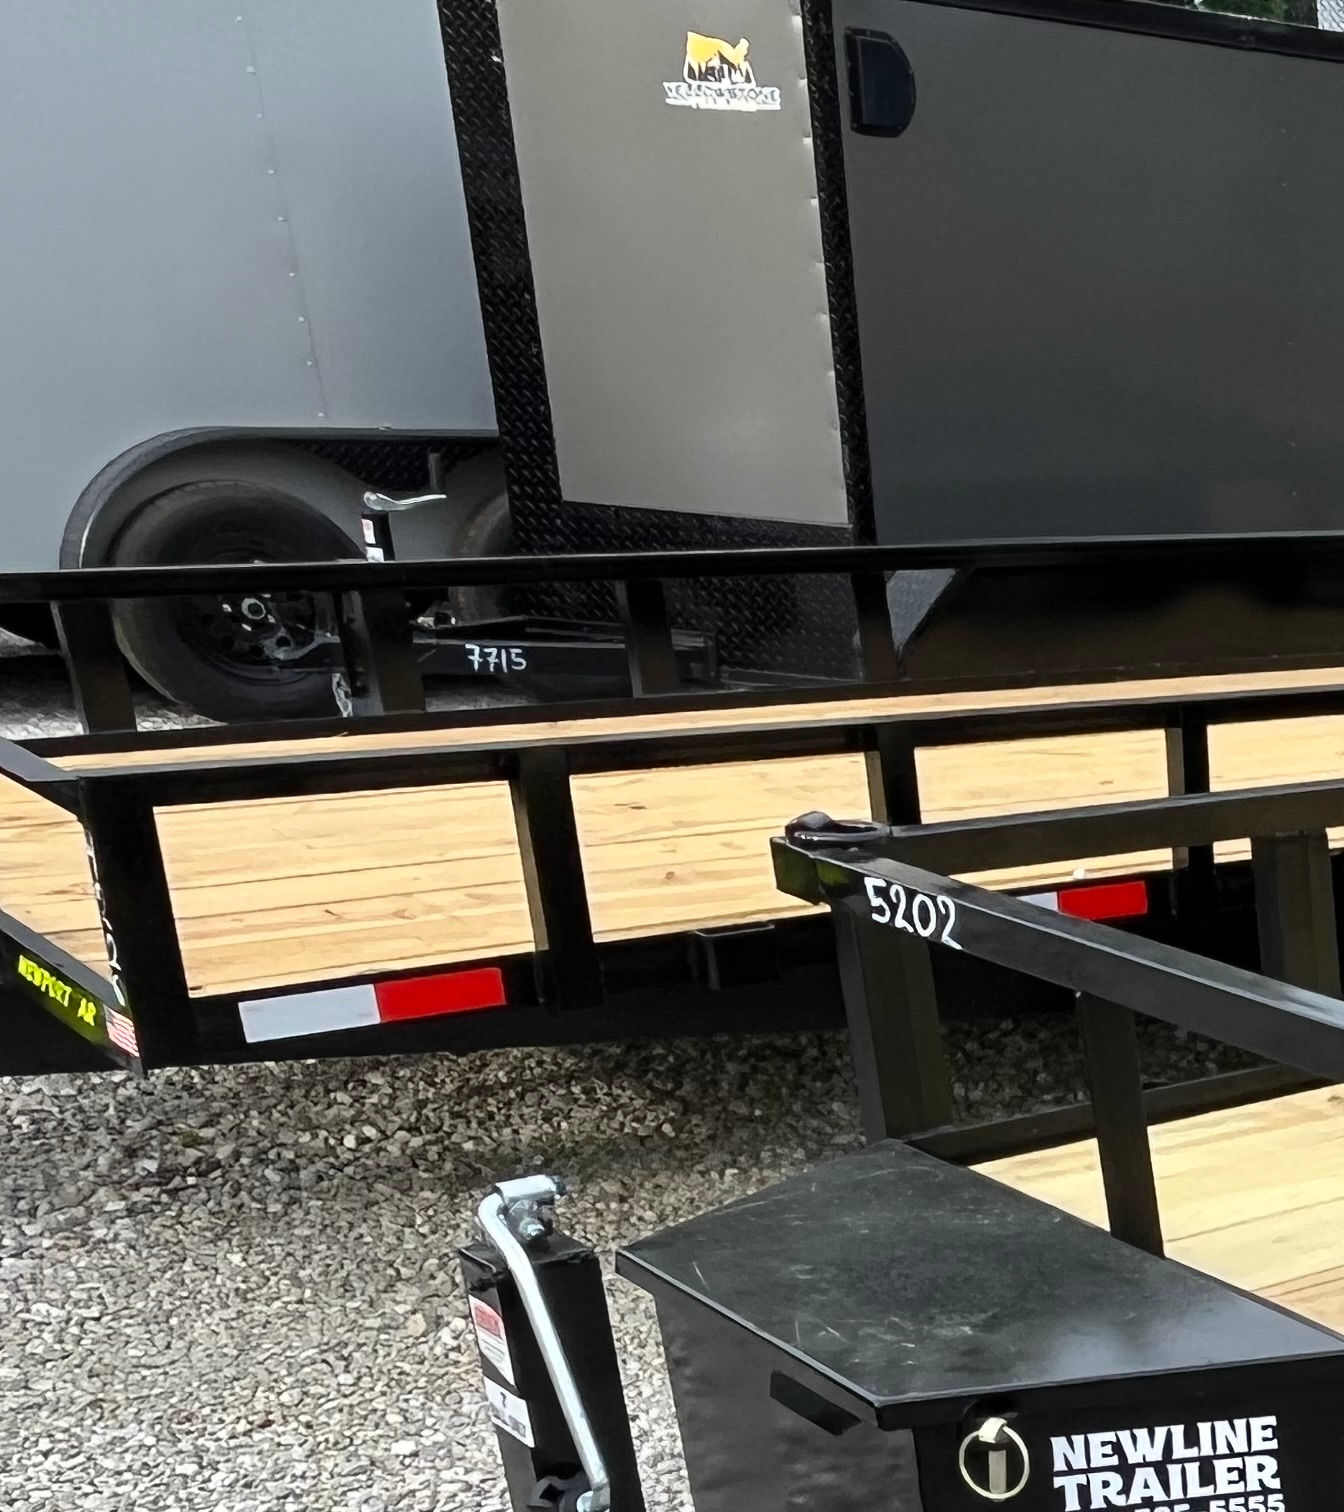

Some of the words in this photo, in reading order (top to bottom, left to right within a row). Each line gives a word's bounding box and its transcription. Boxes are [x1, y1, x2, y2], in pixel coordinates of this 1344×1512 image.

[465, 643, 527, 673] 7715
[864, 876, 962, 950] 5202
[1050, 1415, 1278, 1472] NEWLINE
[1053, 1455, 1281, 1512] TRAILER
